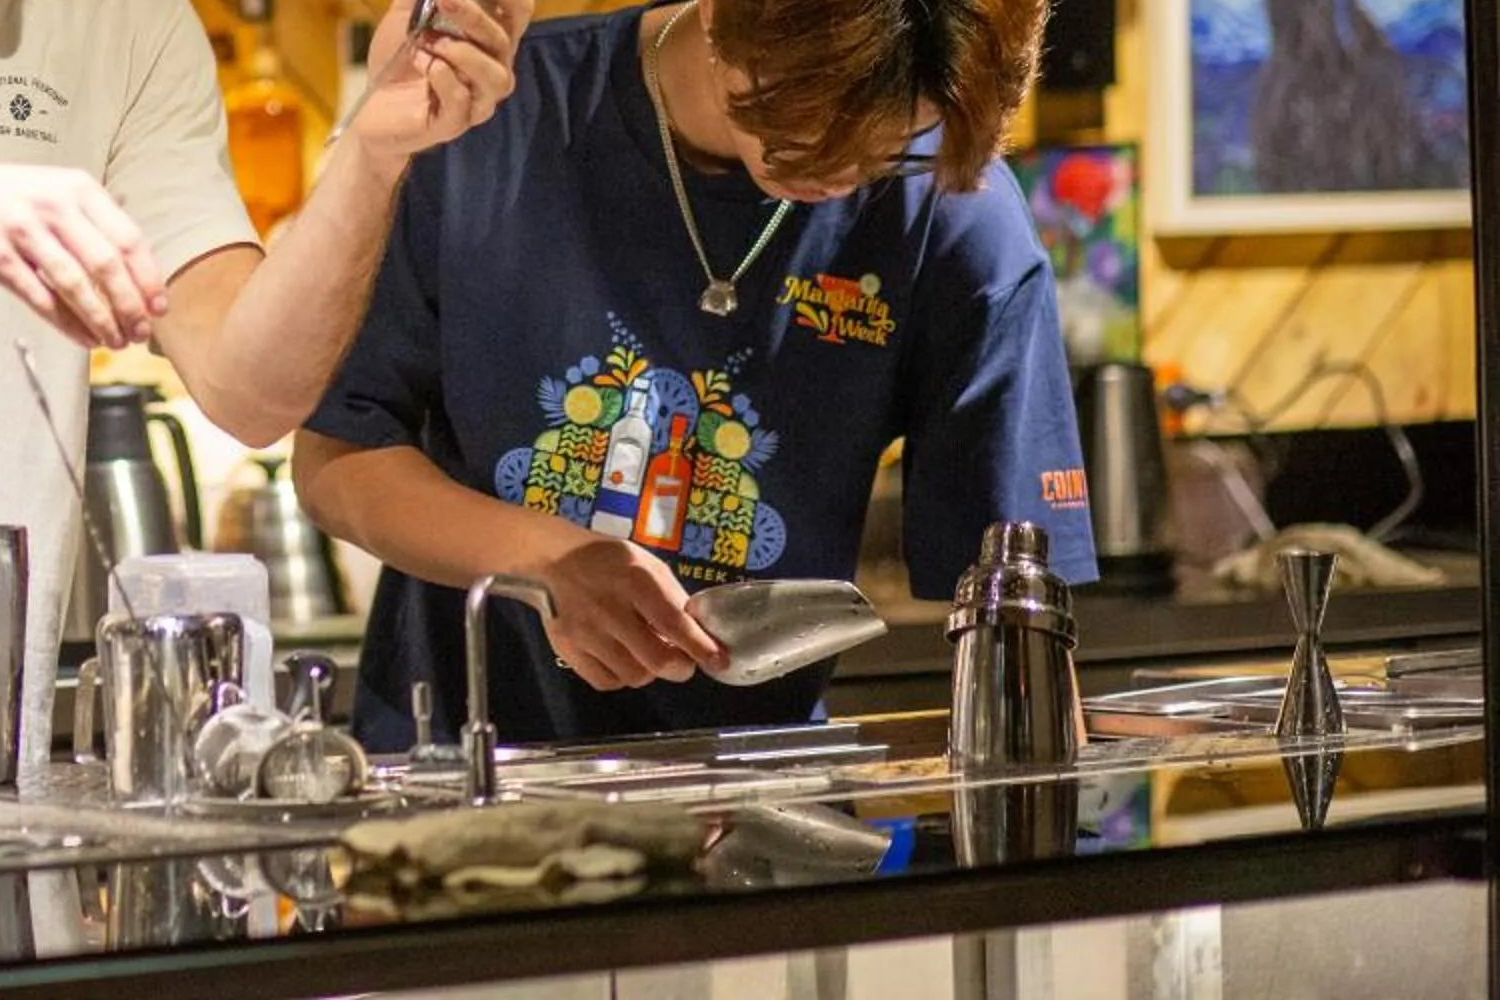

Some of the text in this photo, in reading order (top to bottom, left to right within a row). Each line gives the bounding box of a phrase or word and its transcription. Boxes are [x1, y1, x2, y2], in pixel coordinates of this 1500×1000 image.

[838, 315, 888, 347] Week
[1040, 468, 1087, 501] COIN
[677, 563, 728, 583] WEEK
